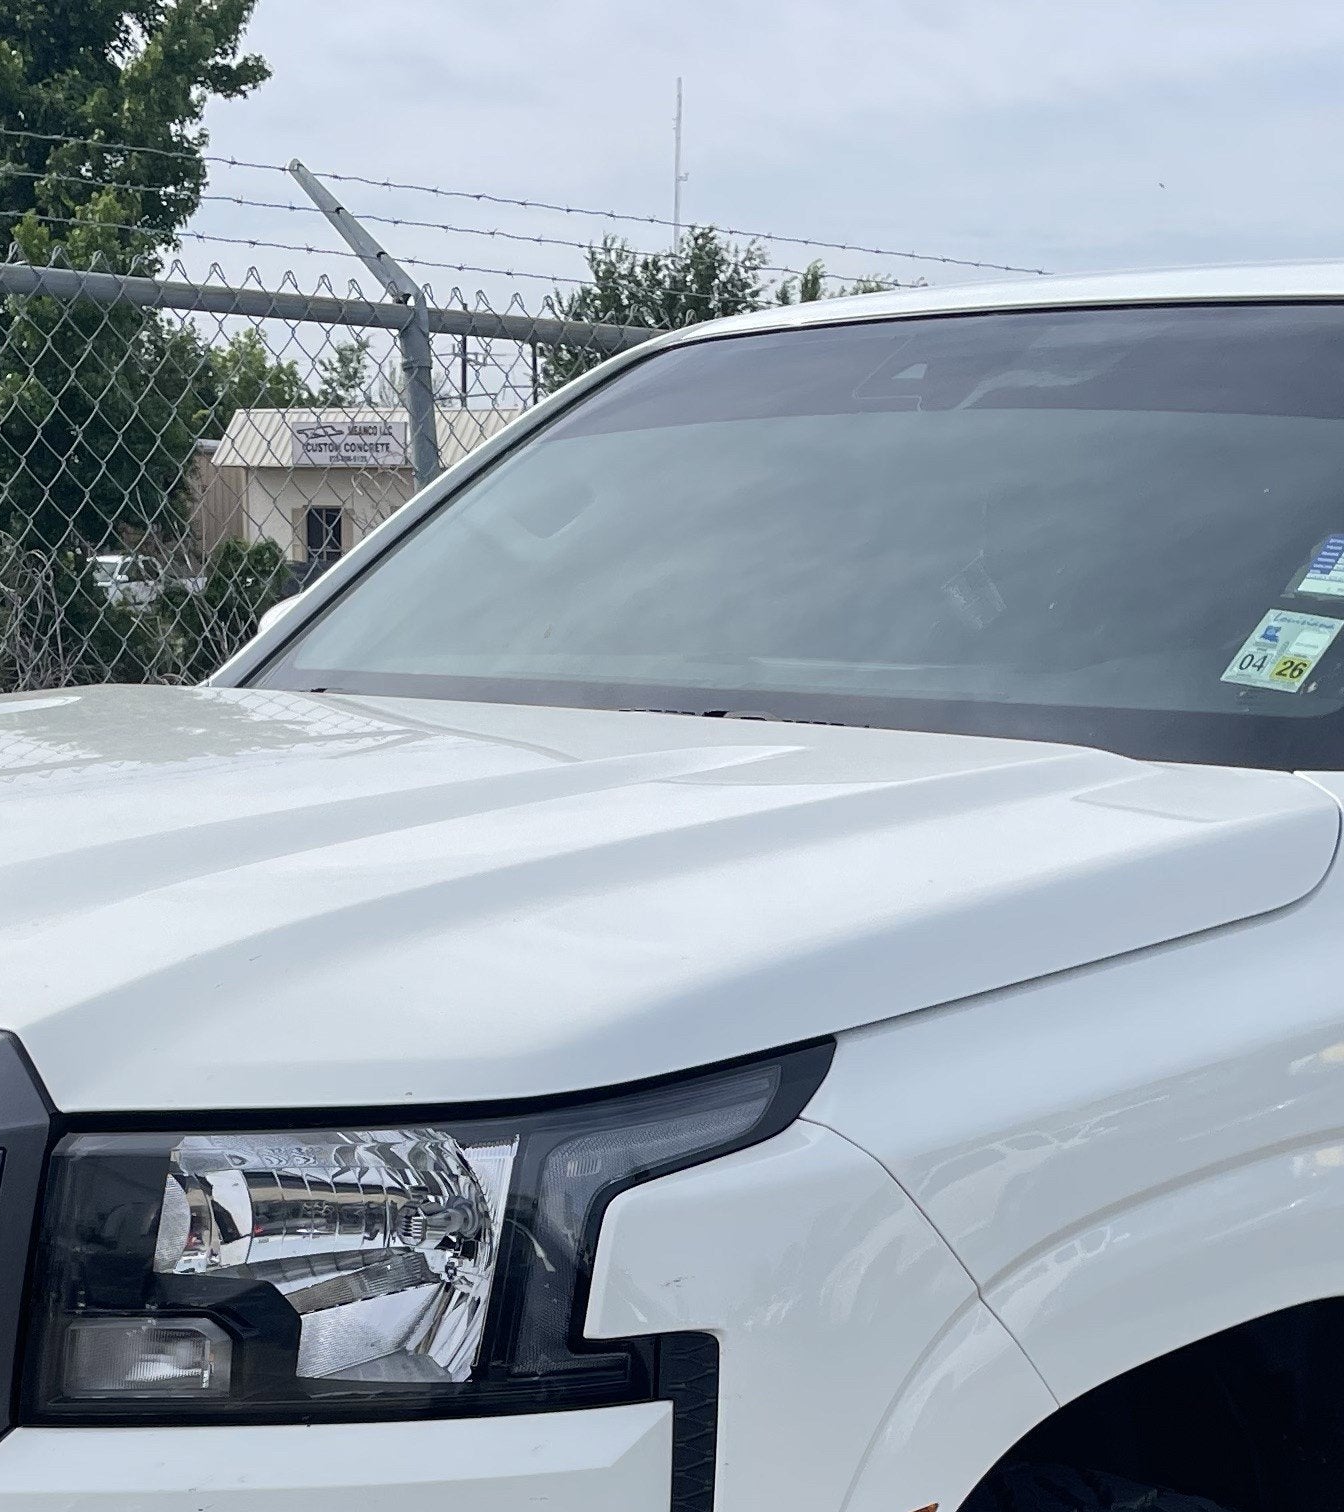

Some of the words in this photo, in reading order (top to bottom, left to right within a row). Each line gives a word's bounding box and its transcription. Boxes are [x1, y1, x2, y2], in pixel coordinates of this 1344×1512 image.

[343, 442, 391, 453] CONCRETE
[1238, 653, 1269, 672] 04
[1275, 659, 1308, 679] 26
